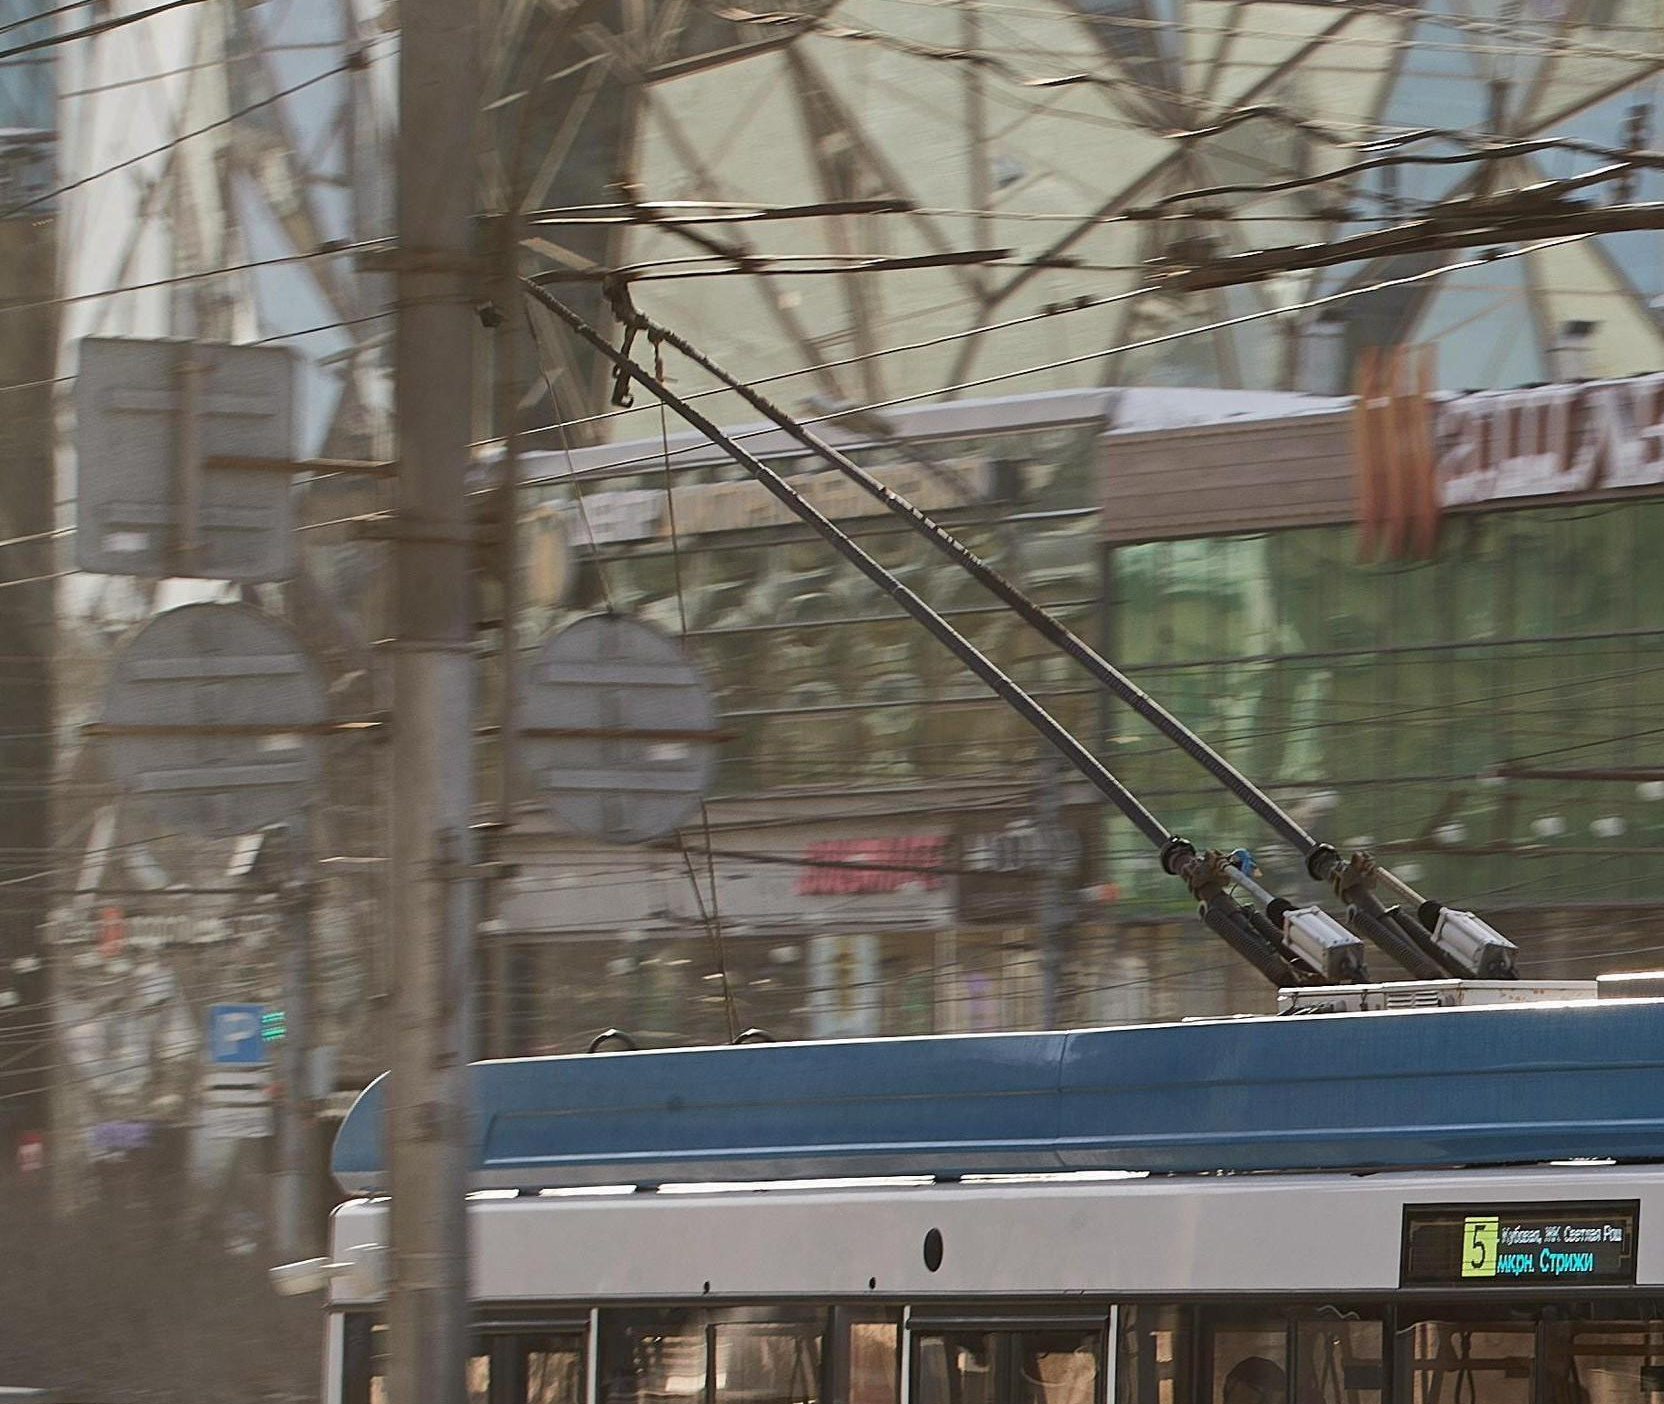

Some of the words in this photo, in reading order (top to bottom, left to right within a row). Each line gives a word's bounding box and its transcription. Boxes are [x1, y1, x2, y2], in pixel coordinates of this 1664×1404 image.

[1471, 1225, 1486, 1268] 5
[1497, 1254, 1535, 1276] мкрн.
[1539, 1247, 1593, 1276] Стрижи
